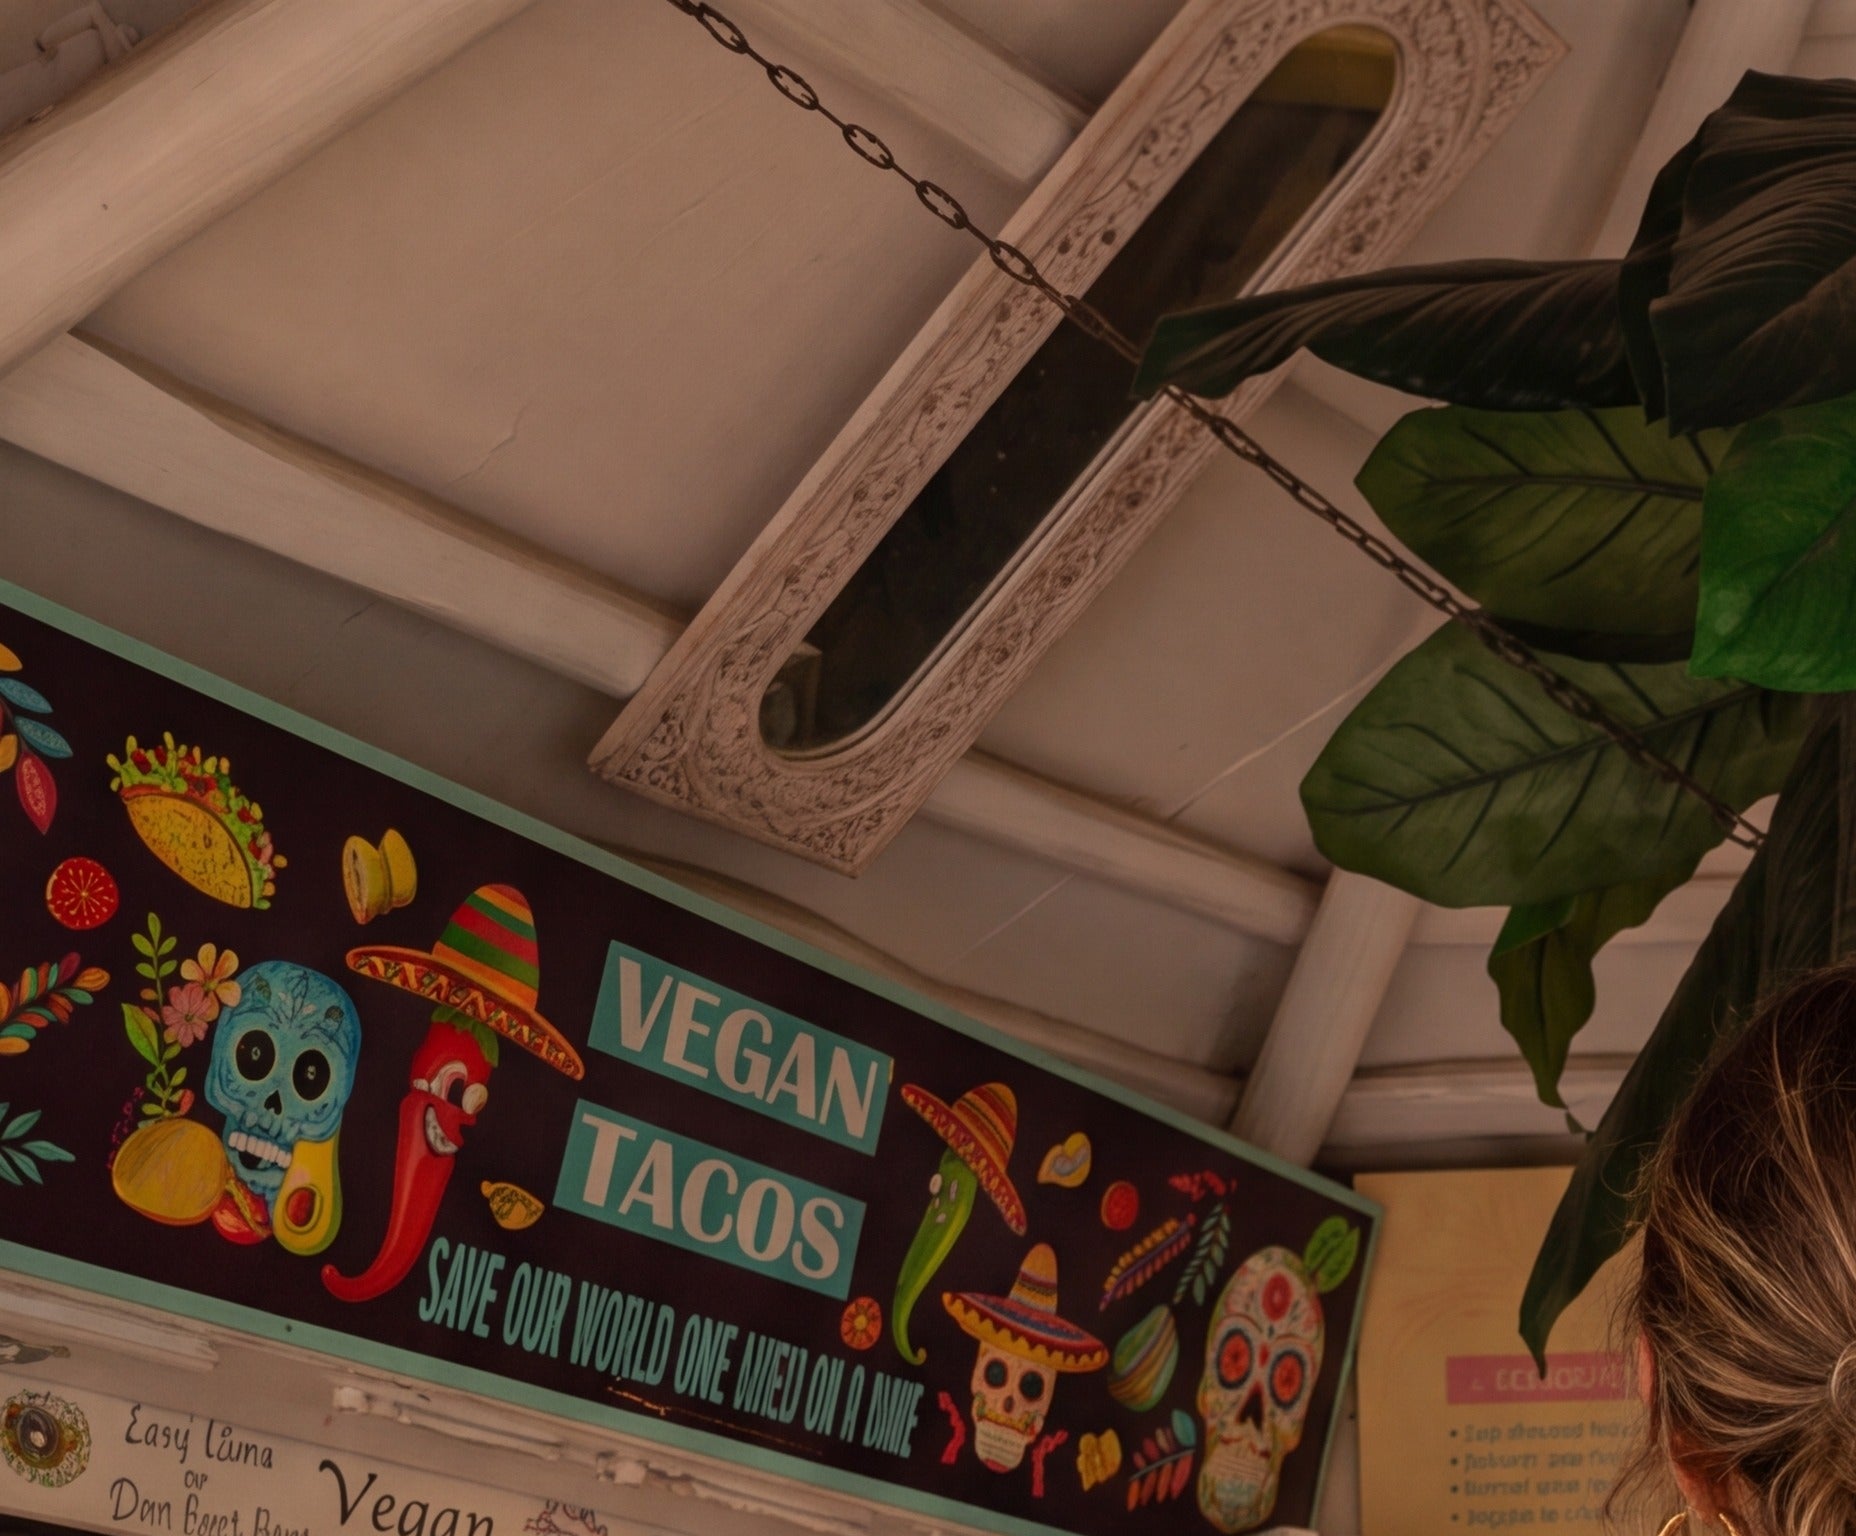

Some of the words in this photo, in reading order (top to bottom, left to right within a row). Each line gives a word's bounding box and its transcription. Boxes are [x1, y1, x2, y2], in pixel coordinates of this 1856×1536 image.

[619, 956, 878, 1139] VEGAN
[582, 1113, 843, 1281] TACOS
[418, 1235, 505, 1339] SAVE
[502, 1261, 571, 1358] OUR
[570, 1280, 675, 1386] WORLD
[673, 1313, 738, 1405] ONE
[839, 1363, 865, 1443] A
